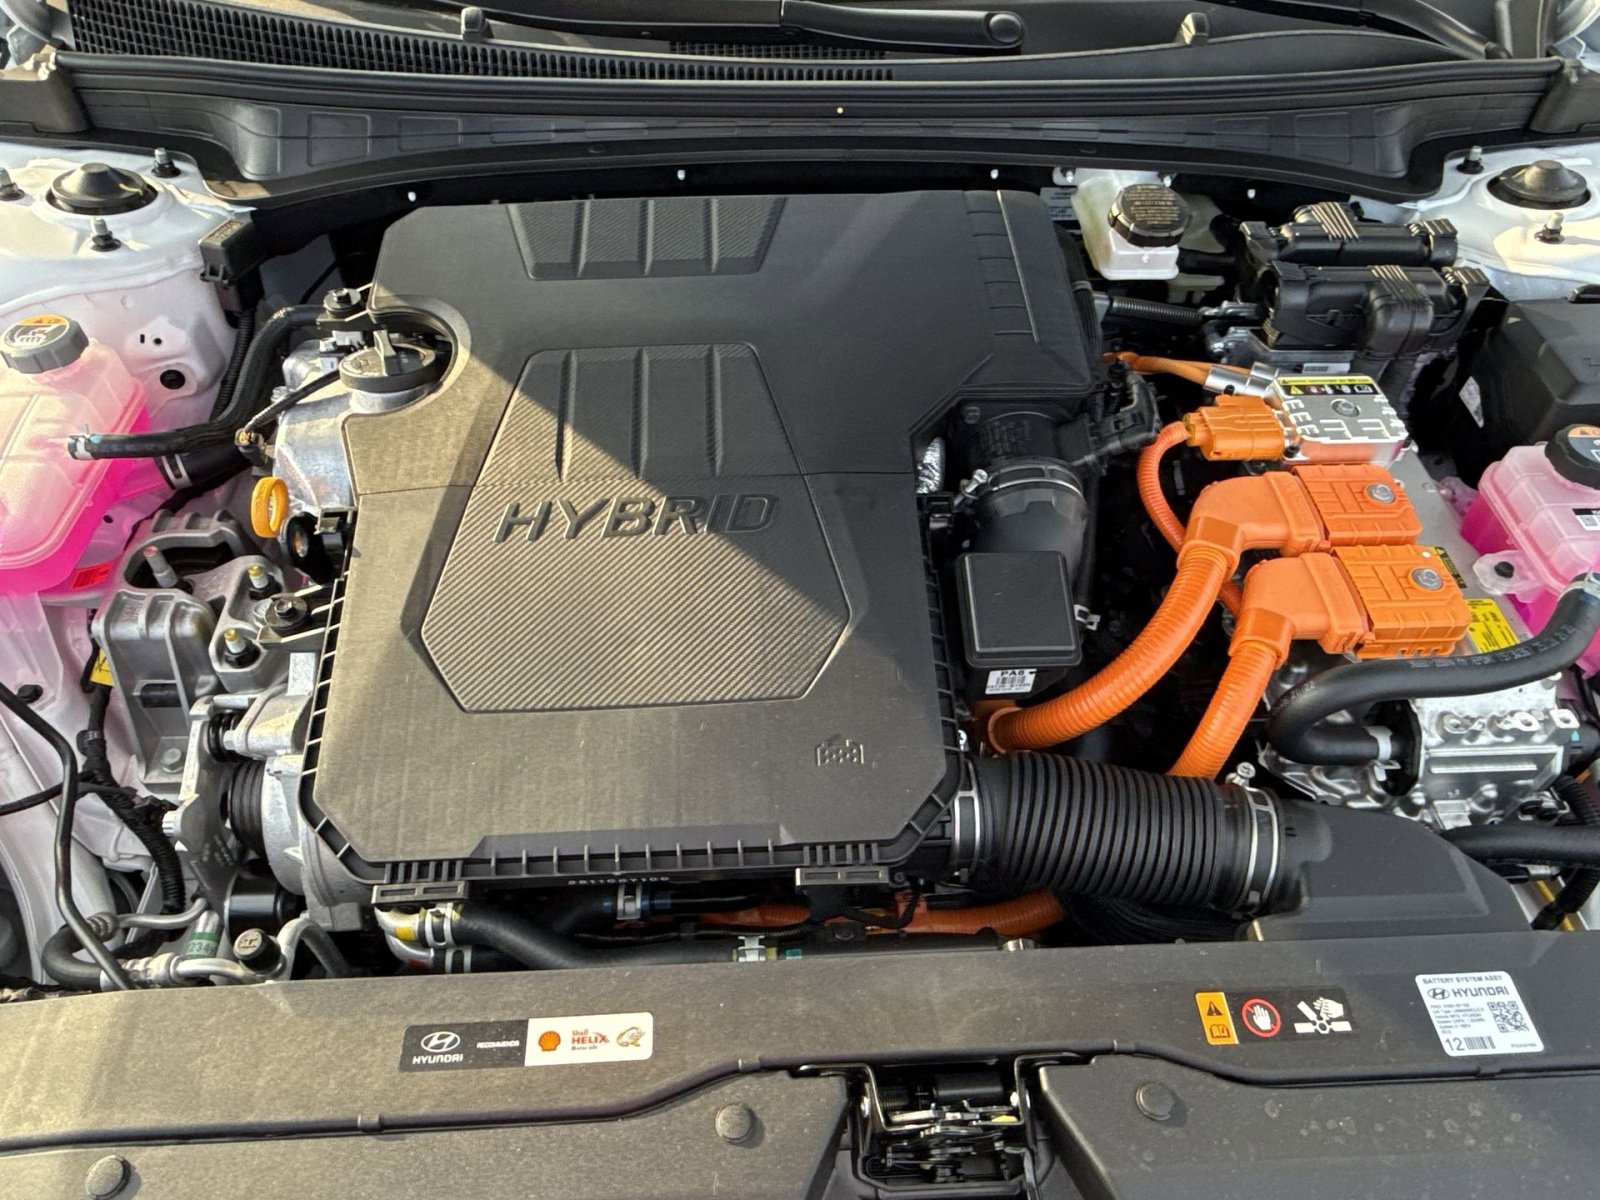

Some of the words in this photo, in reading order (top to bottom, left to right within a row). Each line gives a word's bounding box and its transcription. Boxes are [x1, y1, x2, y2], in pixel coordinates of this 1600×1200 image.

[491, 493, 779, 542] HYBRID
[1455, 975, 1484, 983] SYSTEM
[1451, 986, 1510, 998] HYUNDAI
[572, 1028, 589, 1036] Shell
[571, 1034, 607, 1044] HELIX
[1445, 1037, 1465, 1051] 12
[476, 1040, 520, 1049] RECOMMENDS
[412, 1054, 464, 1065] HYUNDAI
